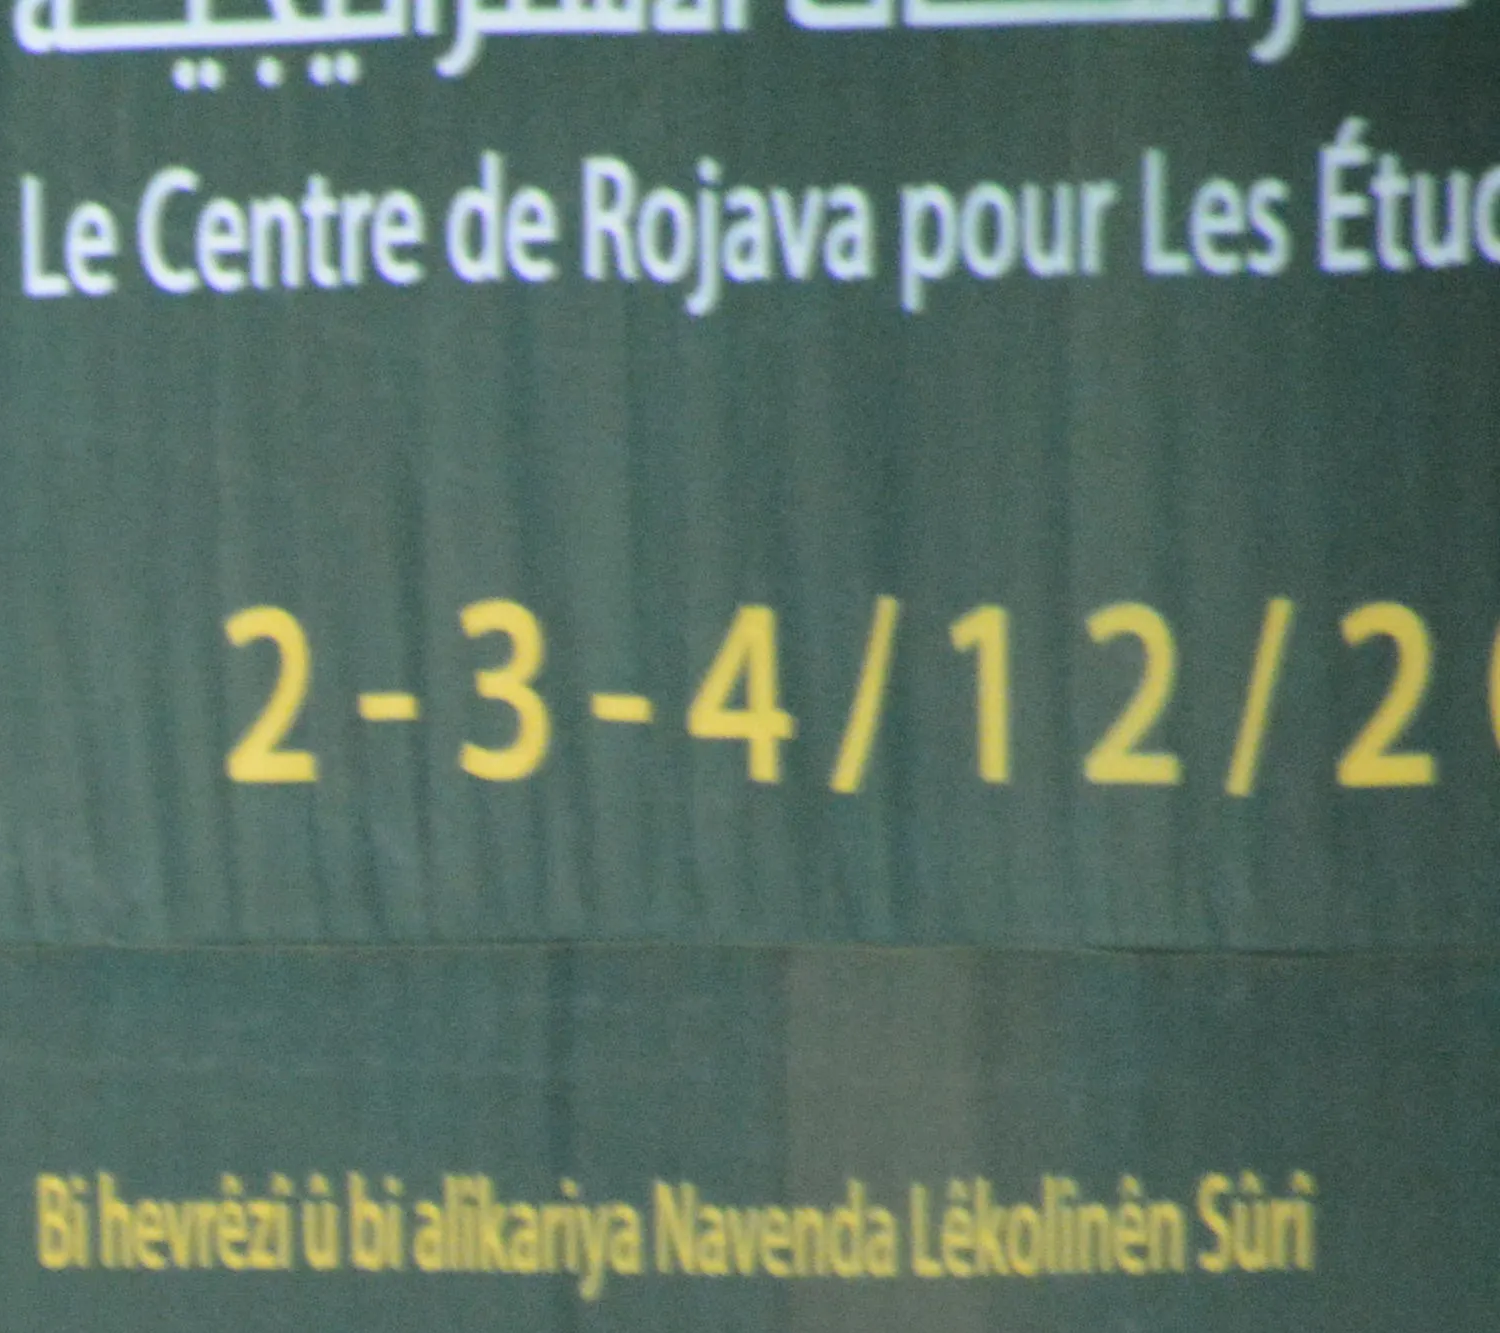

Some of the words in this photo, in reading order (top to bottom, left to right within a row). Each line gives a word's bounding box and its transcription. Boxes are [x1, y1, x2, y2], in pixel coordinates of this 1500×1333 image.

[21, 175, 119, 298] Le
[137, 167, 425, 294] Centre
[446, 151, 559, 283] de
[582, 156, 872, 315] Rojava
[902, 183, 1120, 311] pour
[1144, 151, 1287, 274] Les
[349, 1174, 404, 1271] bi
[654, 1181, 899, 1278] Navenda
